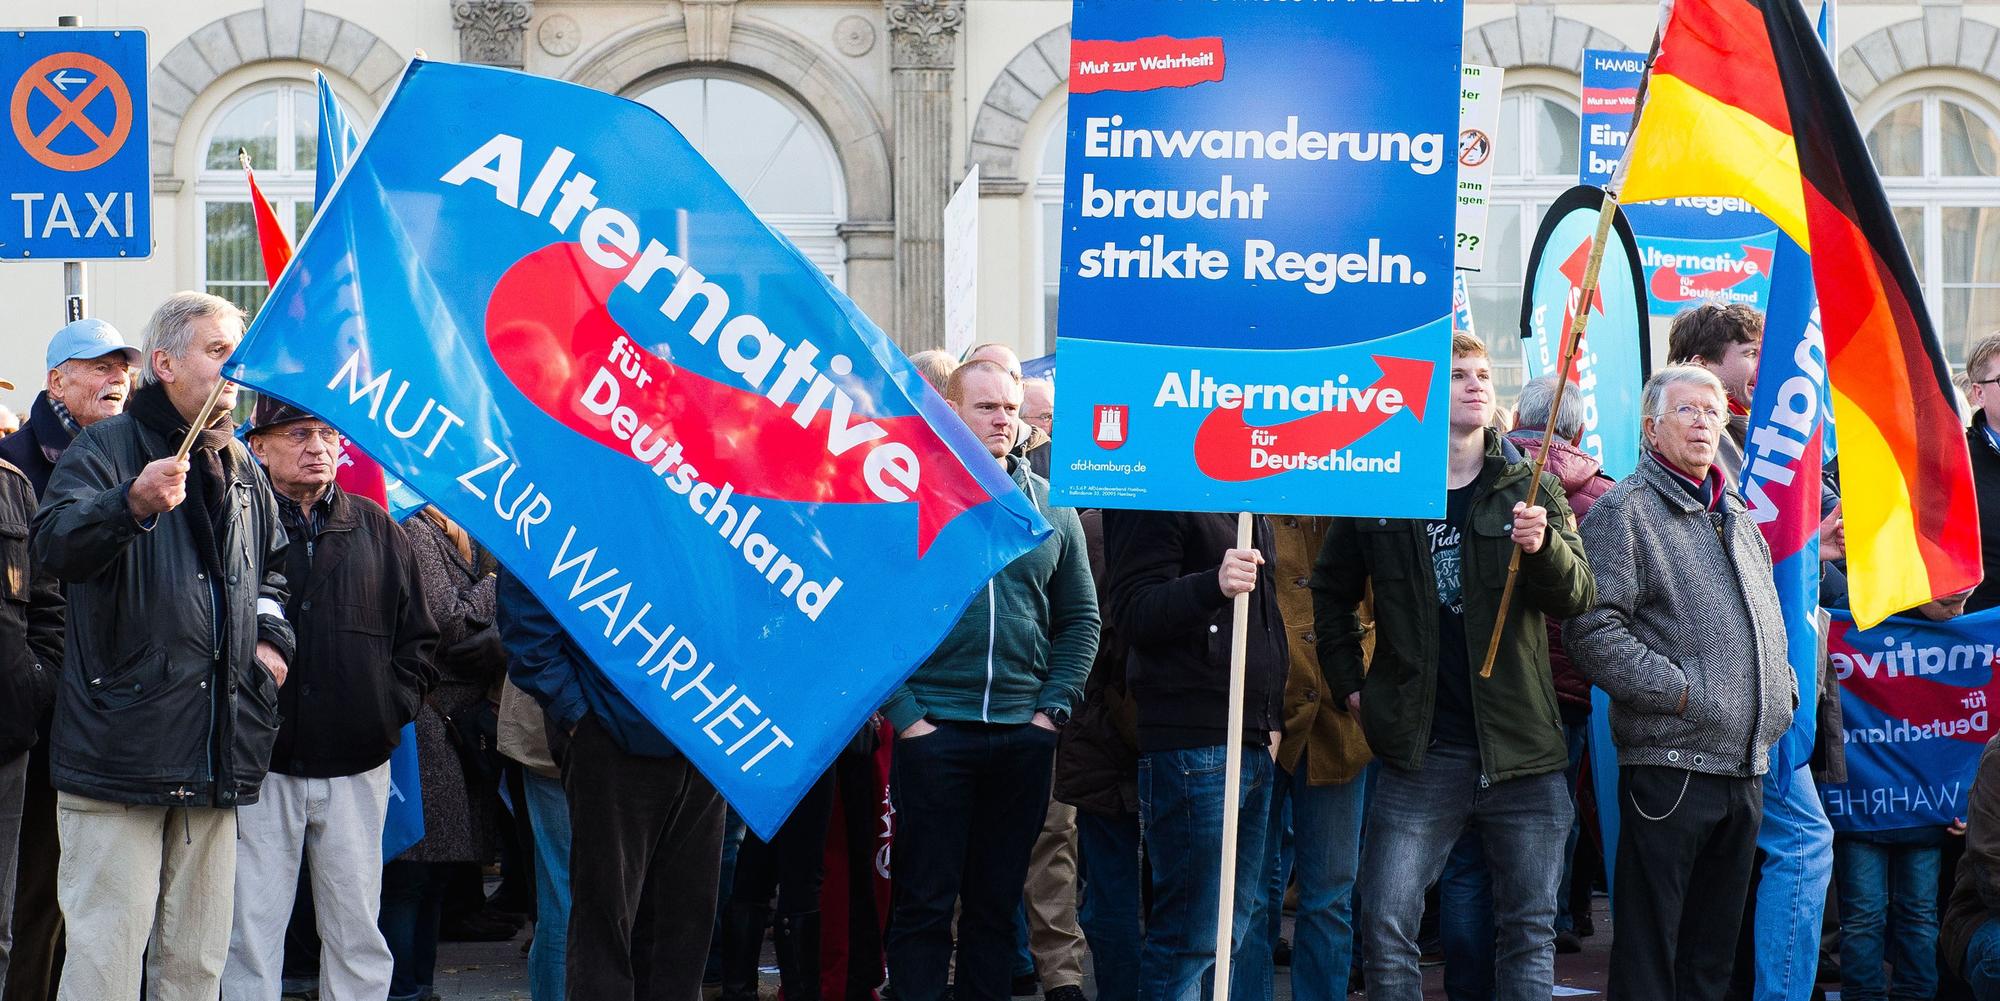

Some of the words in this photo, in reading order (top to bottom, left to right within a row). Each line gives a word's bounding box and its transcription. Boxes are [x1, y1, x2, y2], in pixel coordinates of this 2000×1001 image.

[1079, 60, 1110, 75] Mut
[1112, 59, 1137, 72] zur
[1140, 51, 1214, 70] Wahrheit!
[1462, 67, 1480, 76] nn
[1587, 97, 1602, 105] Mut
[1084, 115, 1443, 175] Einwanderung
[1590, 123, 1629, 146] Ein
[10, 192, 134, 239] TAXI
[1081, 173, 1270, 220] braucht
[1077, 235, 1230, 280] strikte
[1243, 237, 1427, 295] Regeln.
[1679, 276, 1695, 287] für
[439, 132, 921, 503] Alternative
[607, 335, 652, 390] für
[1153, 368, 1404, 415] Alternative
[1250, 429, 1278, 447] für
[1250, 447, 1401, 474] Deutschland
[1070, 459, 1147, 475] afd-hamburg.de
[580, 366, 844, 622] Deutschland
[327, 348, 464, 458] MUT
[456, 437, 552, 550] ZUR
[548, 524, 794, 773] WAHRHEIT
